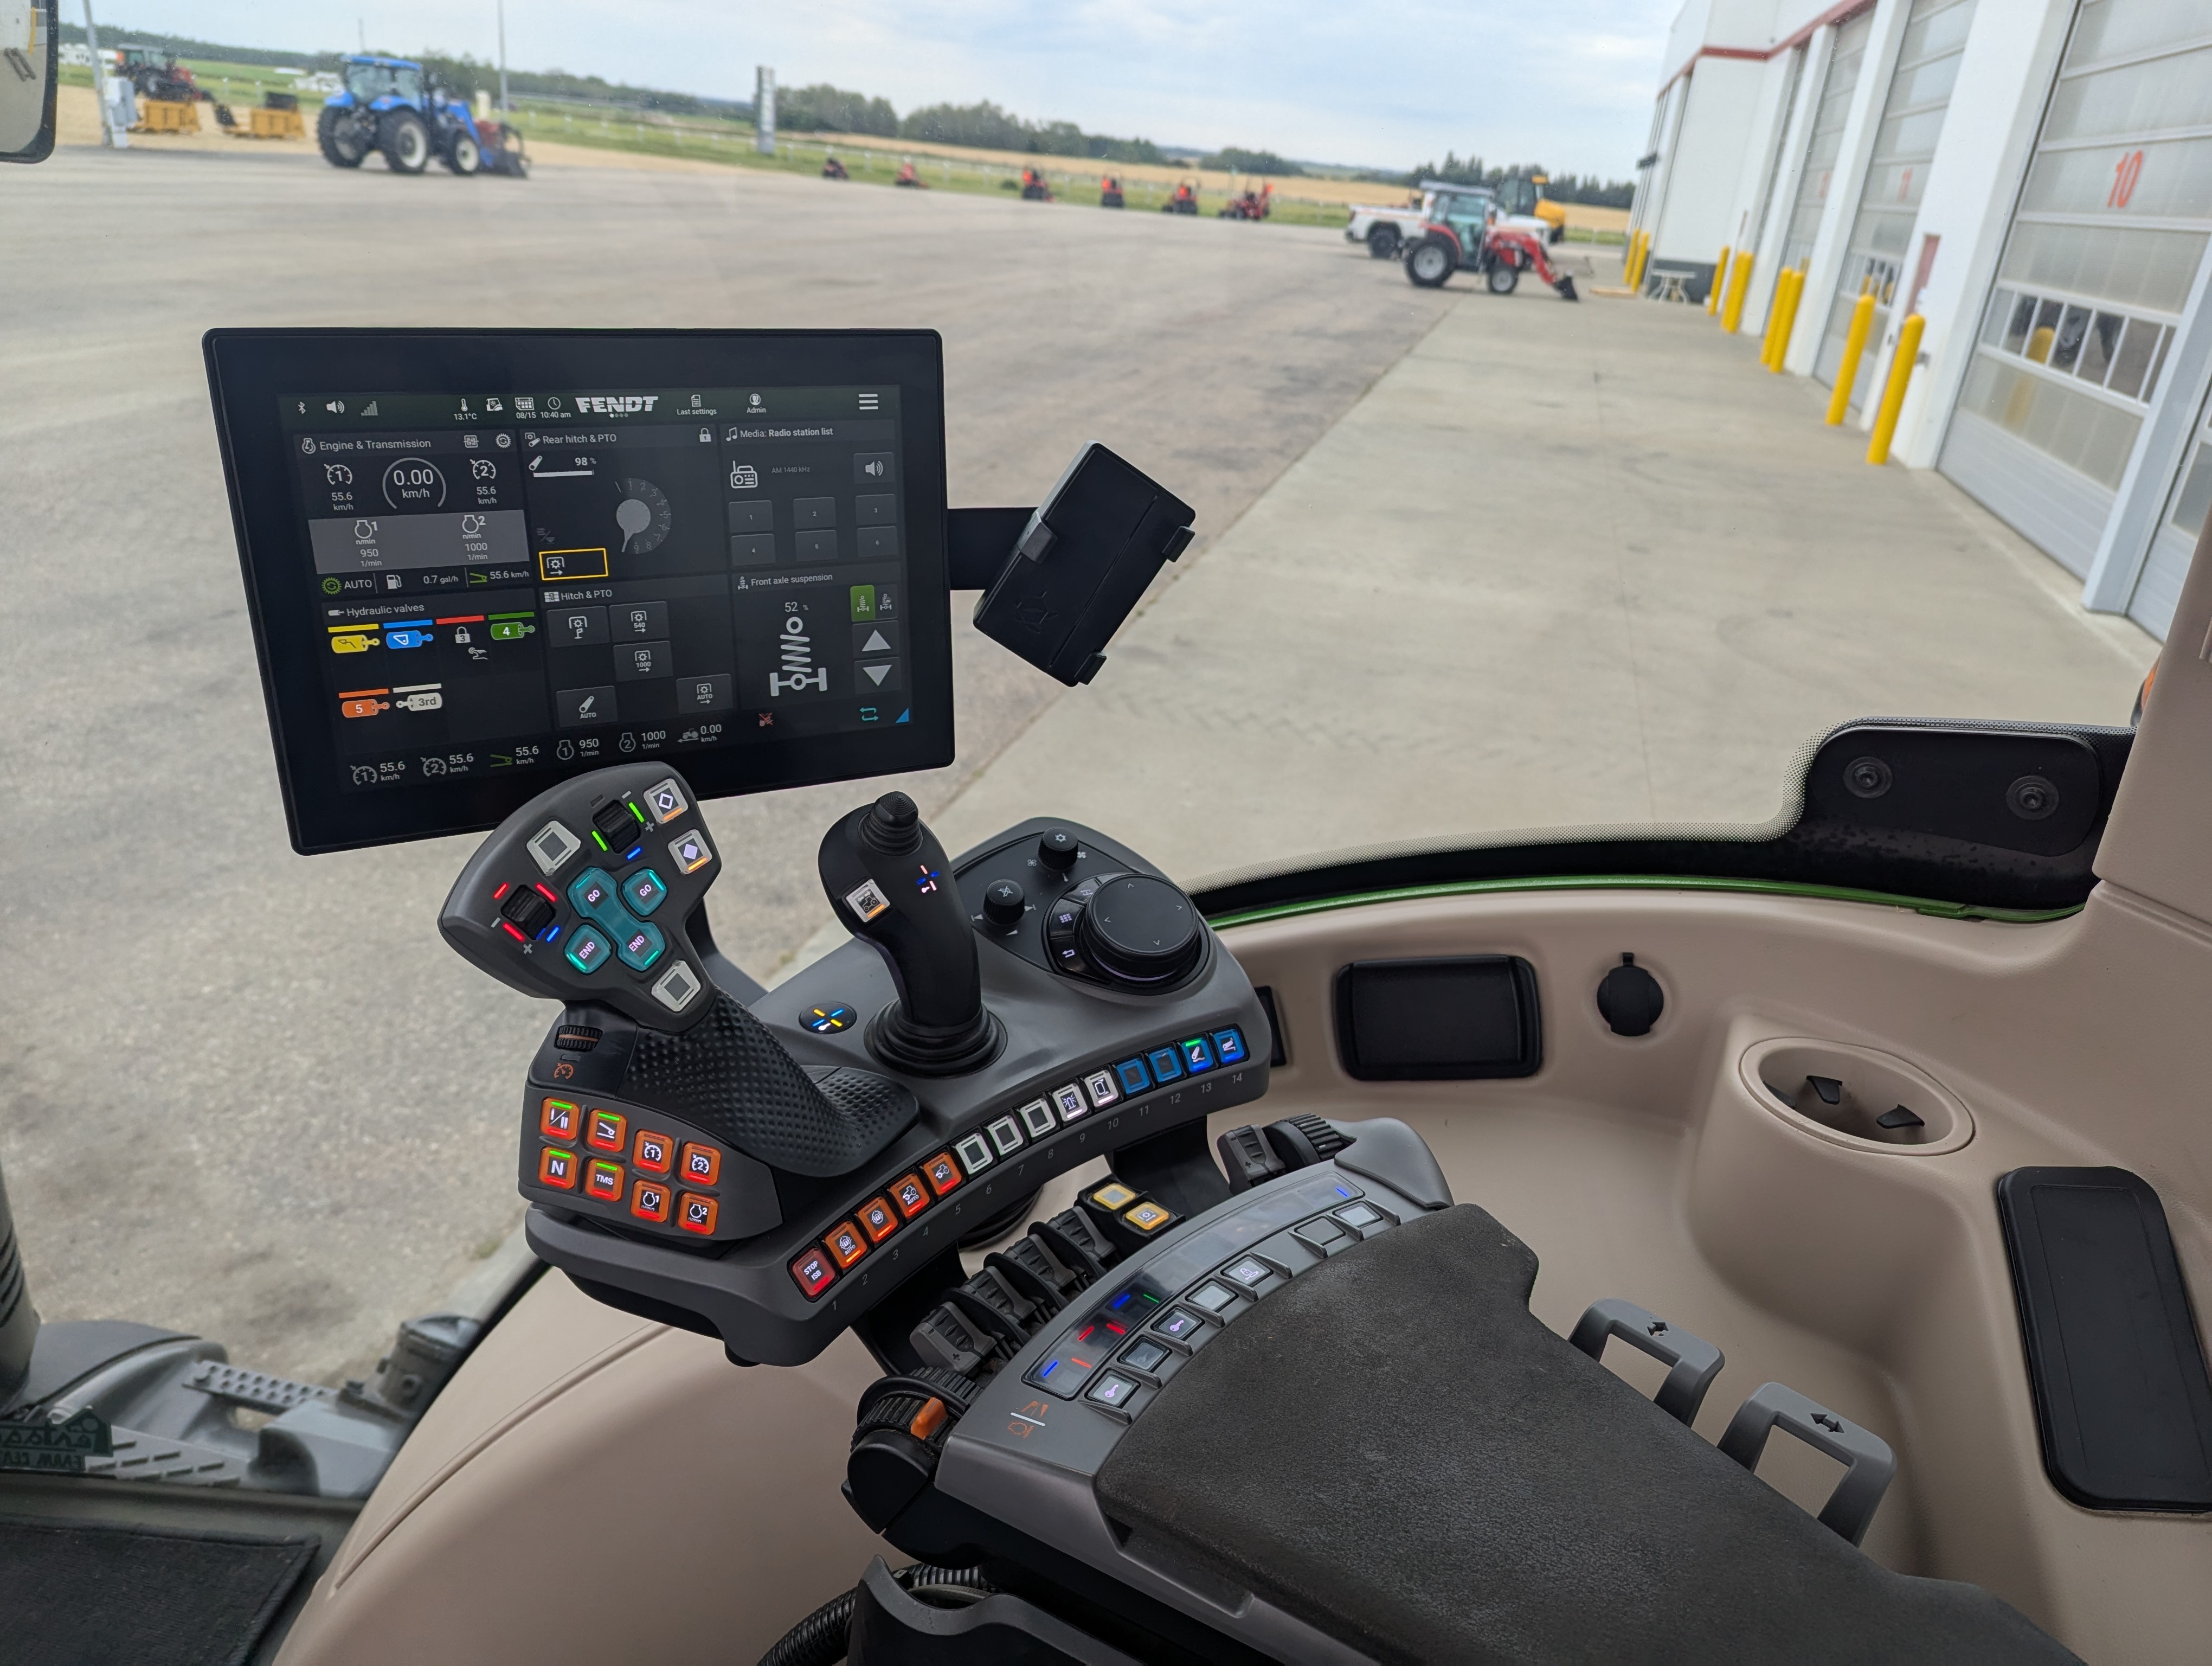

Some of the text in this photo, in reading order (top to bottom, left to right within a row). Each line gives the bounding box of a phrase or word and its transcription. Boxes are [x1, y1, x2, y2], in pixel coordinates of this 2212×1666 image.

[2106, 150, 2143, 208] 10
[575, 396, 658, 413] FENDT
[768, 429, 792, 437] Radio
[543, 434, 616, 444] Rear hitch & PTO
[319, 439, 431, 452] Engine & Transmission
[575, 457, 588, 466] 98
[394, 469, 433, 485] 0.00
[402, 488, 430, 498] km/h
[477, 486, 497, 495] 55.6
[331, 492, 353, 501] 55.6
[371, 521, 378, 531] 1
[478, 516, 486, 526] 2
[465, 542, 487, 552] 1000
[360, 549, 378, 558] 950
[423, 575, 459, 585] 0.7 gal/h
[490, 571, 509, 579] 55.6
[751, 573, 833, 586] Front axle suspension
[344, 579, 372, 589] AUTO
[561, 591, 585, 600] Hitch
[594, 589, 613, 598] PTO
[346, 604, 425, 618] Hydraulic valves
[785, 602, 799, 612] 52
[503, 627, 510, 636] 4
[418, 697, 437, 706] 3rd
[356, 704, 363, 713] 5
[700, 724, 722, 734] 0.00
[641, 731, 666, 741] 1000
[579, 738, 599, 748] 950
[515, 746, 539, 757] 55.6
[449, 753, 473, 764] 55.6
[516, 757, 534, 765] km/h
[380, 761, 405, 772] 55.6
[381, 773, 400, 781] km/h
[588, 889, 600, 902] GO
[639, 884, 652, 896] GO
[628, 935, 645, 952] END
[578, 941, 595, 959] END
[1231, 1073, 1243, 1084] 14
[1201, 1082, 1212, 1094] 13
[1170, 1093, 1181, 1104] 12
[1139, 1106, 1150, 1117] 11
[1107, 1118, 1119, 1130] 10
[1079, 1133, 1086, 1143] 9
[1047, 1149, 1053, 1159] 8
[551, 1160, 564, 1176] N
[1018, 1164, 1025, 1176] 7
[596, 1174, 613, 1186] TMS
[986, 1184, 992, 1195] 6
[907, 1194, 919, 1206] AUTO
[702, 1207, 708, 1215] 2
[955, 1203, 961, 1215] 5
[923, 1226, 929, 1236] 4
[845, 1245, 856, 1256] AUTO
[893, 1249, 898, 1260] 3
[803, 1260, 818, 1275] STOP
[811, 1270, 822, 1281] ISB
[863, 1274, 868, 1286] 2
[832, 1300, 837, 1310] 1
